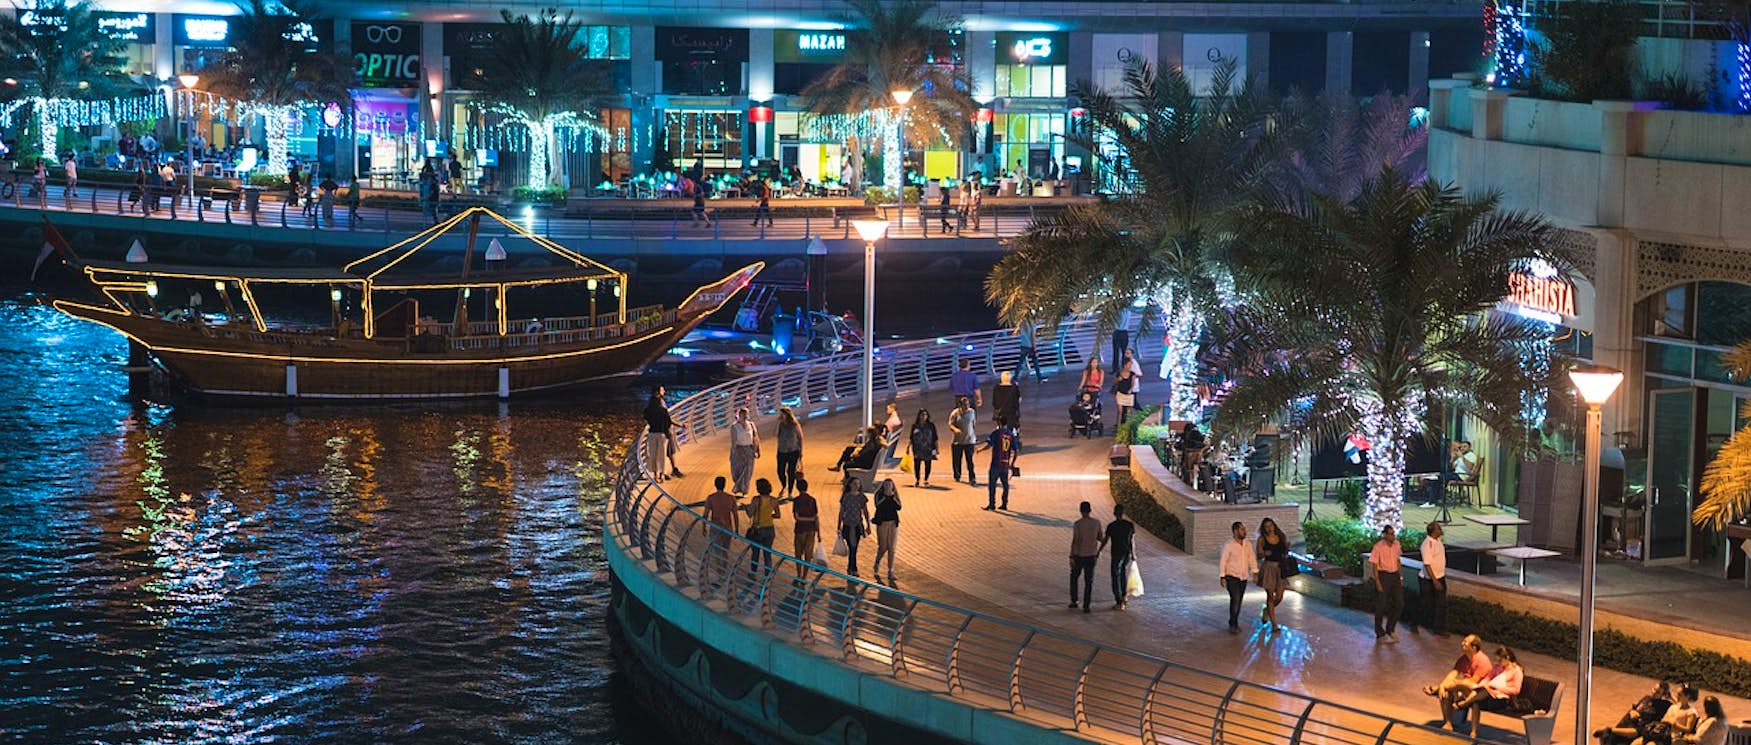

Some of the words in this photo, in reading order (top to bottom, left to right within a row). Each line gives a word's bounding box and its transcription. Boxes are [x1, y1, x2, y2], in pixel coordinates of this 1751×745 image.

[799, 34, 845, 49] MAZAH
[1117, 46, 1132, 63] Q
[1207, 47, 1222, 63] Q
[352, 52, 419, 79] OPTIC
[1507, 271, 1577, 318] SHAHISTA
